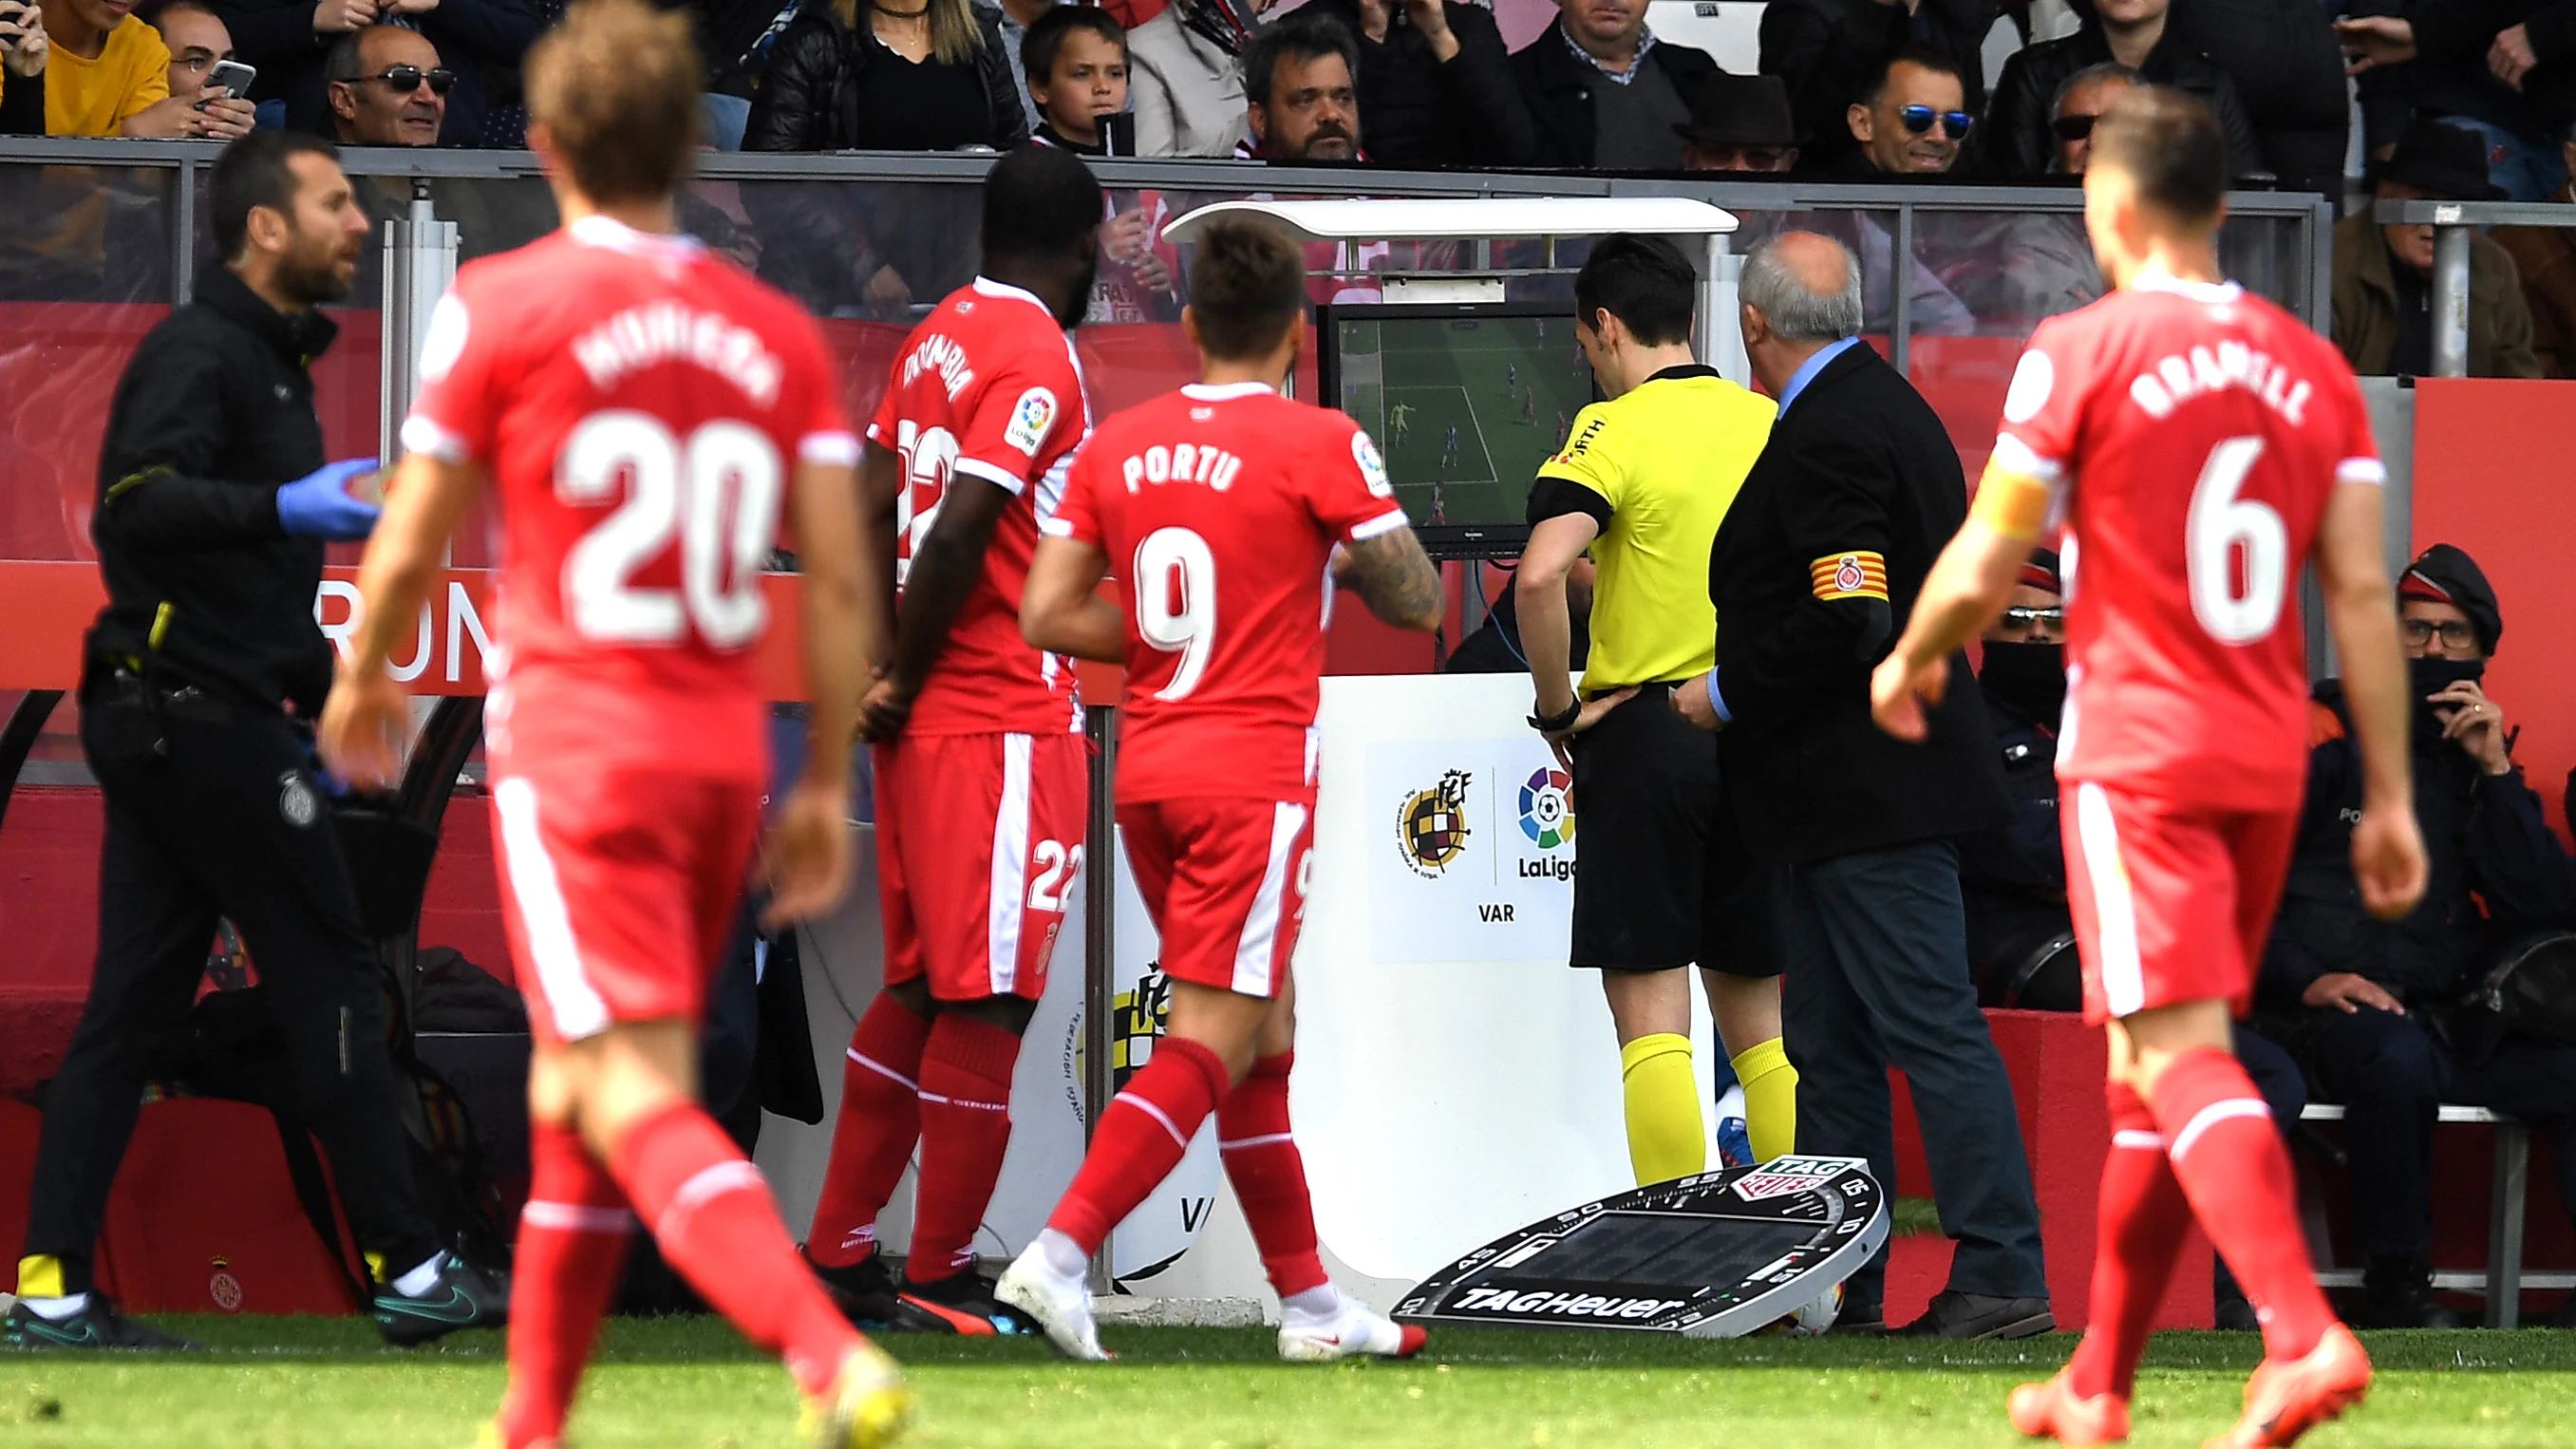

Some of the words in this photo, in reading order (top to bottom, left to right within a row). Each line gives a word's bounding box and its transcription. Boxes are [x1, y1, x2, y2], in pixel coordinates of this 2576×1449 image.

[1123, 443, 1242, 494] PORTU
[555, 408, 785, 652] 20
[2185, 435, 2287, 648] 6
[1133, 526, 1217, 702] 9
[1477, 904, 1514, 923] VAR
[1772, 1158, 1845, 1176] TAG
[1678, 1172, 1722, 1188] 55
[1741, 1175, 1825, 1197] HEUER
[1840, 1177, 1871, 1197] 05
[1556, 1202, 1603, 1222] 50
[1836, 1215, 1866, 1234] 10
[1457, 1249, 1496, 1270] 45
